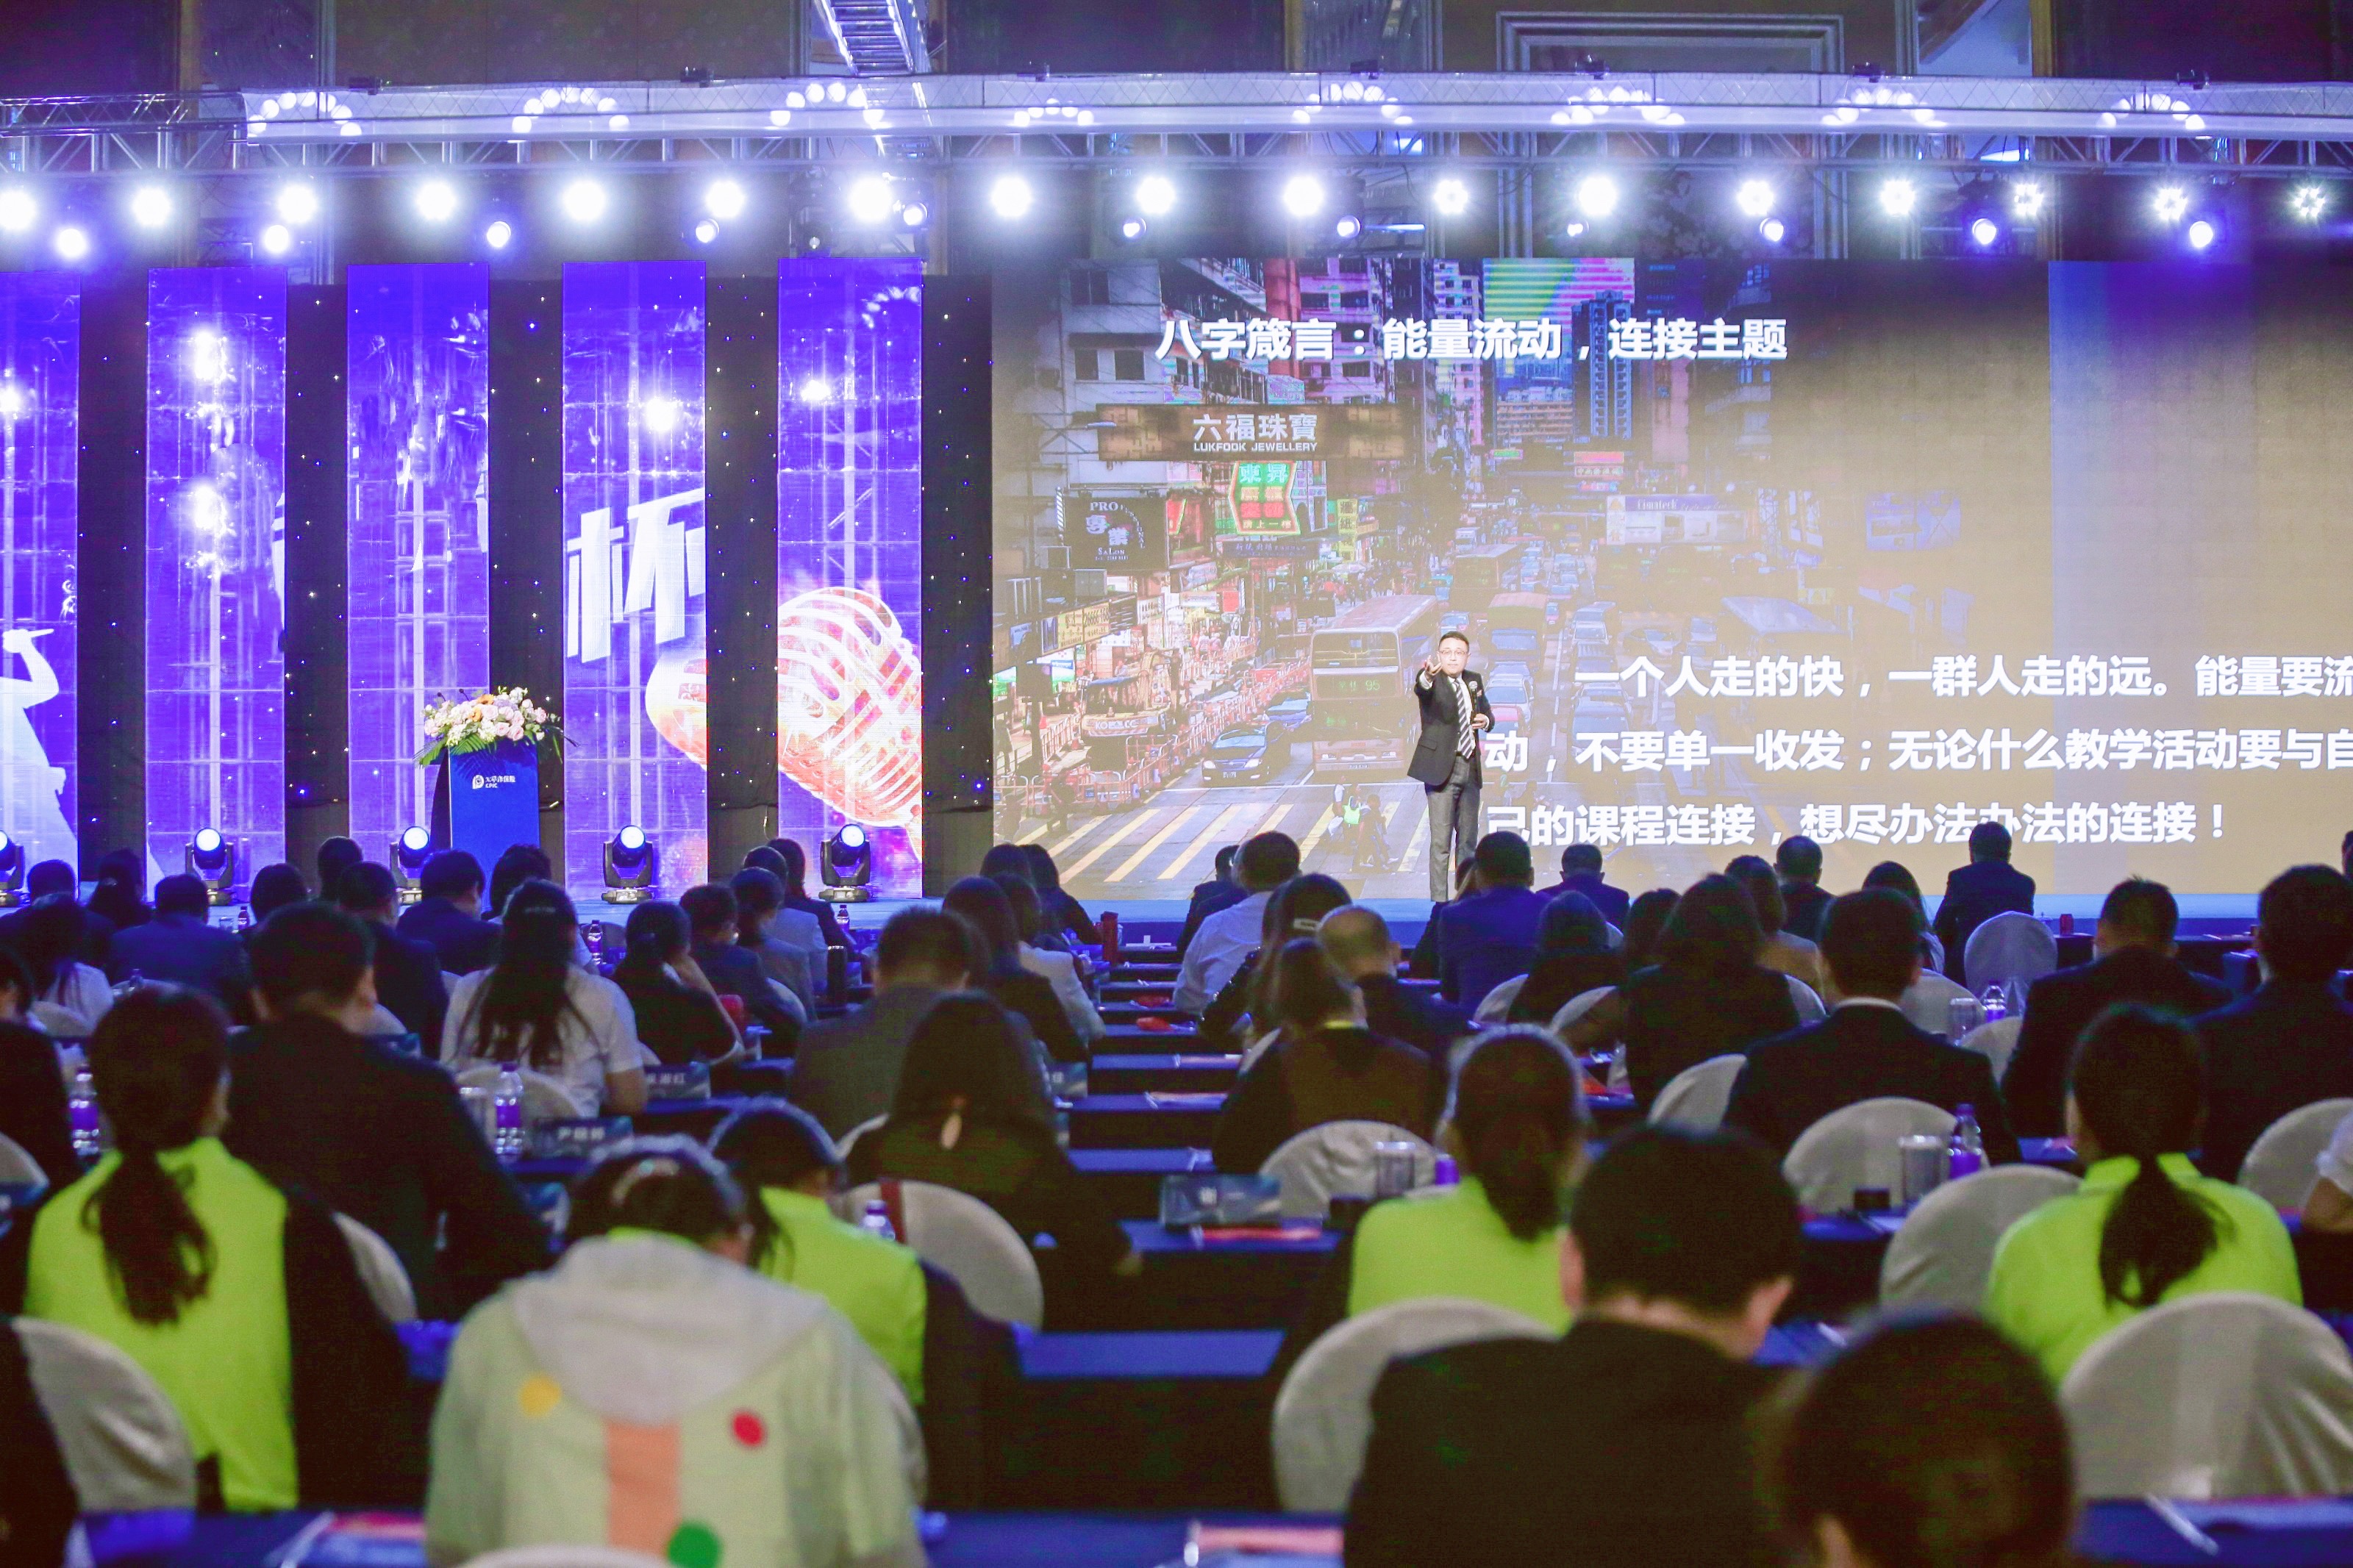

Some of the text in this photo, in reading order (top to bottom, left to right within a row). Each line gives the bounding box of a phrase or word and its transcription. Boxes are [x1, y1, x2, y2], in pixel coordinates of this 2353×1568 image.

[1156, 318, 1788, 361] 八字箴言：能量流动，连接主题
[1193, 413, 1318, 441] 六福珠寶
[1193, 442, 1318, 452] LUKFOOK JEWELLERY
[1484, 728, 2353, 772] 动，不要单一收发；无论什么教学活动要与自
